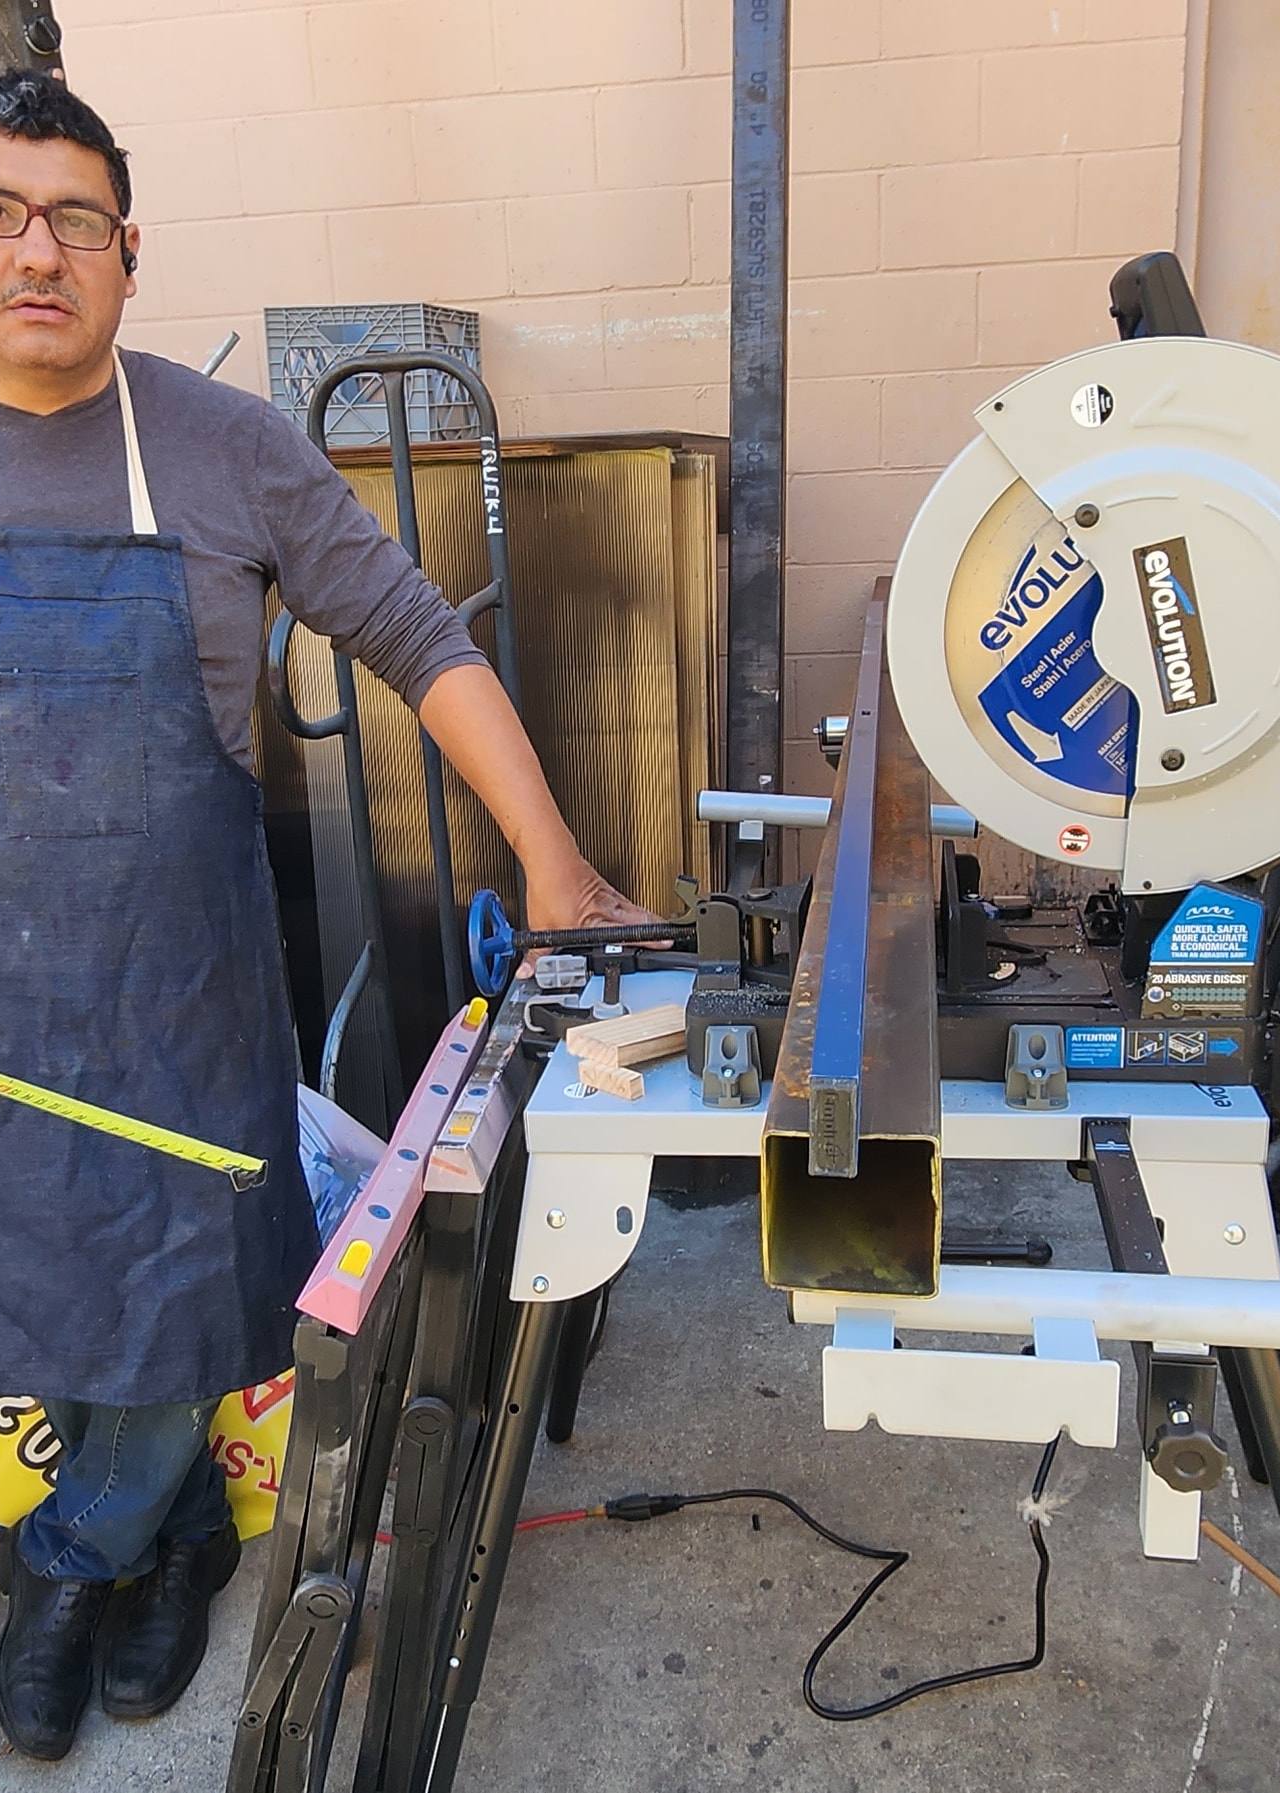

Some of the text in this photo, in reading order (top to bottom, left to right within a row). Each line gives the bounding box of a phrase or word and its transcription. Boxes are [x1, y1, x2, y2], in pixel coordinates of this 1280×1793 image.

[480, 432, 500, 513] TRUCK
[1021, 631, 1077, 689] Steel Acier
[1032, 639, 1092, 699] Stahl Acero
[1067, 702, 1087, 723] MADE
[1086, 694, 1096, 705] IN
[1171, 943, 1178, 951] &
[1172, 934, 1248, 942] MORE ACCURATE
[1152, 974, 1163, 984] 20
[1164, 974, 1212, 984] ABRASIVE
[1071, 1033, 1117, 1042] ATTENTION
